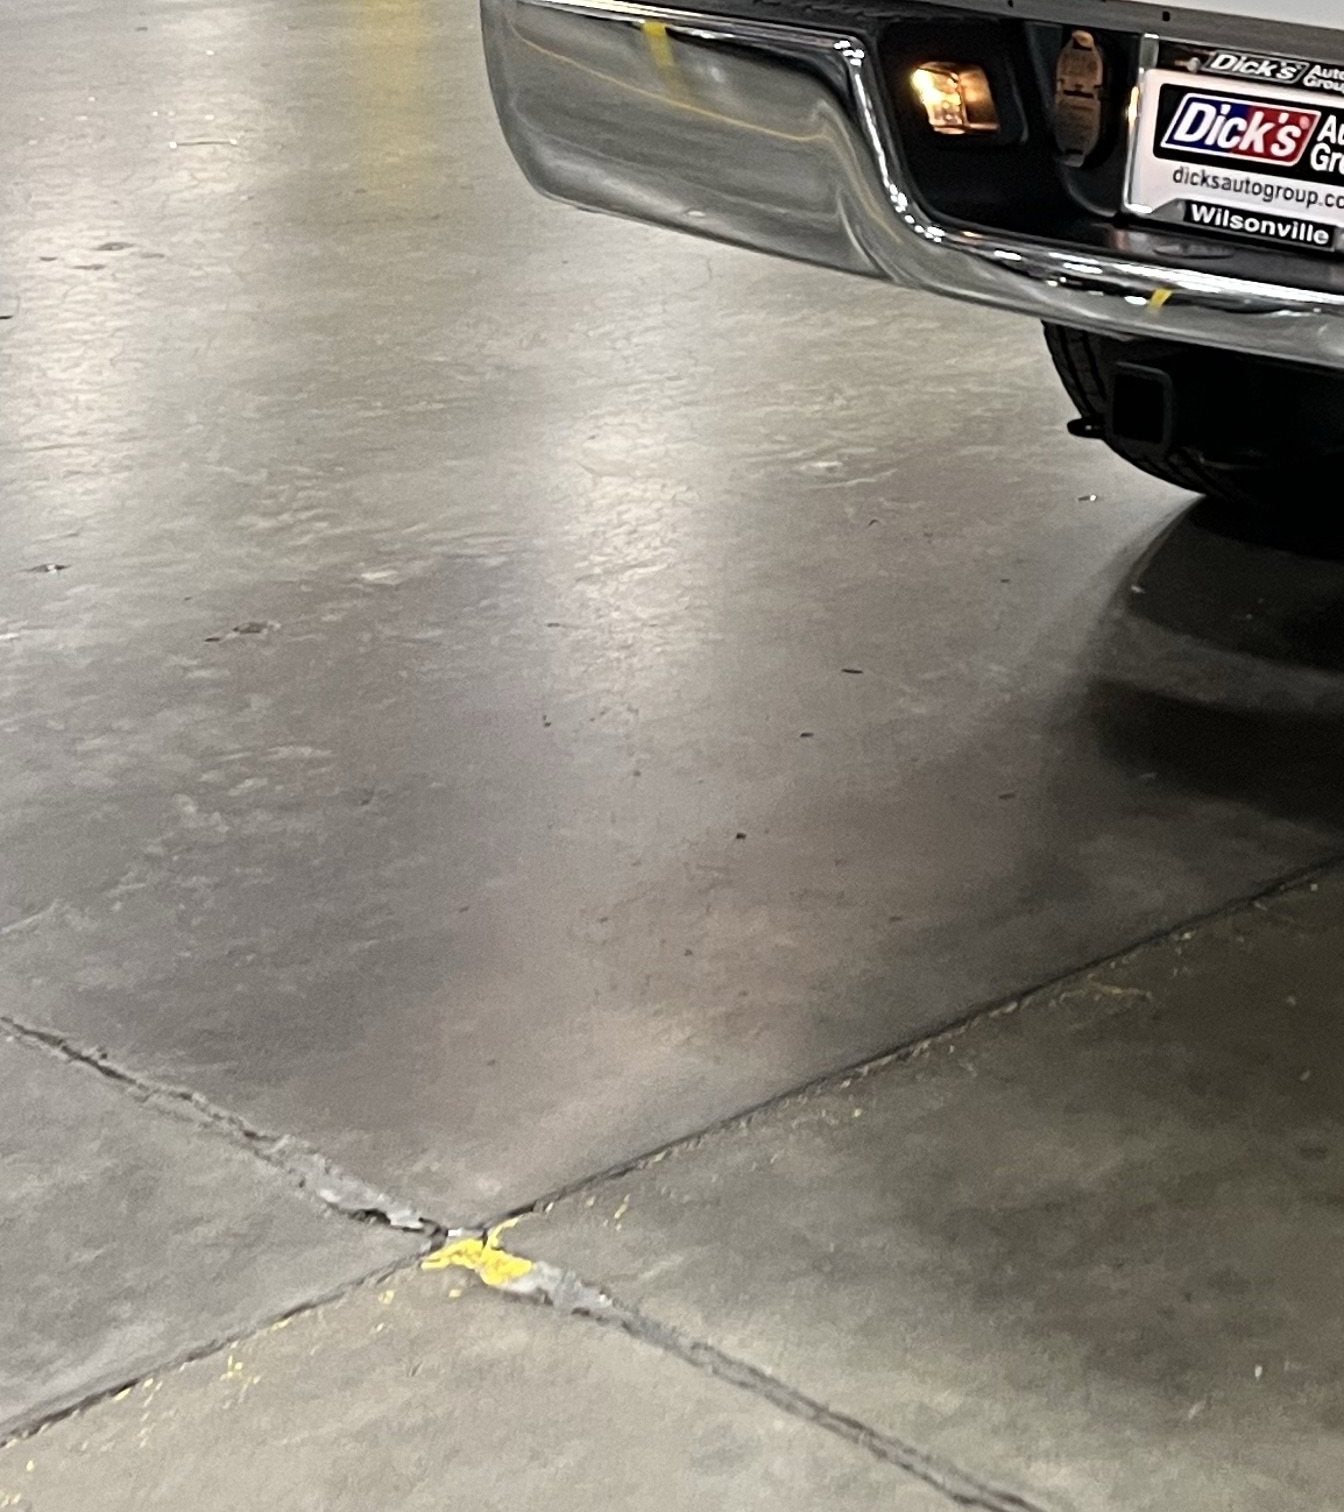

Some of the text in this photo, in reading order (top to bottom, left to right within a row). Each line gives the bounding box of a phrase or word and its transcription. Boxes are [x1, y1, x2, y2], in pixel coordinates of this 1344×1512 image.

[1210, 54, 1298, 80] Dick's
[1173, 101, 1302, 157] Dick's
[1189, 203, 1330, 245] Wilsonville
